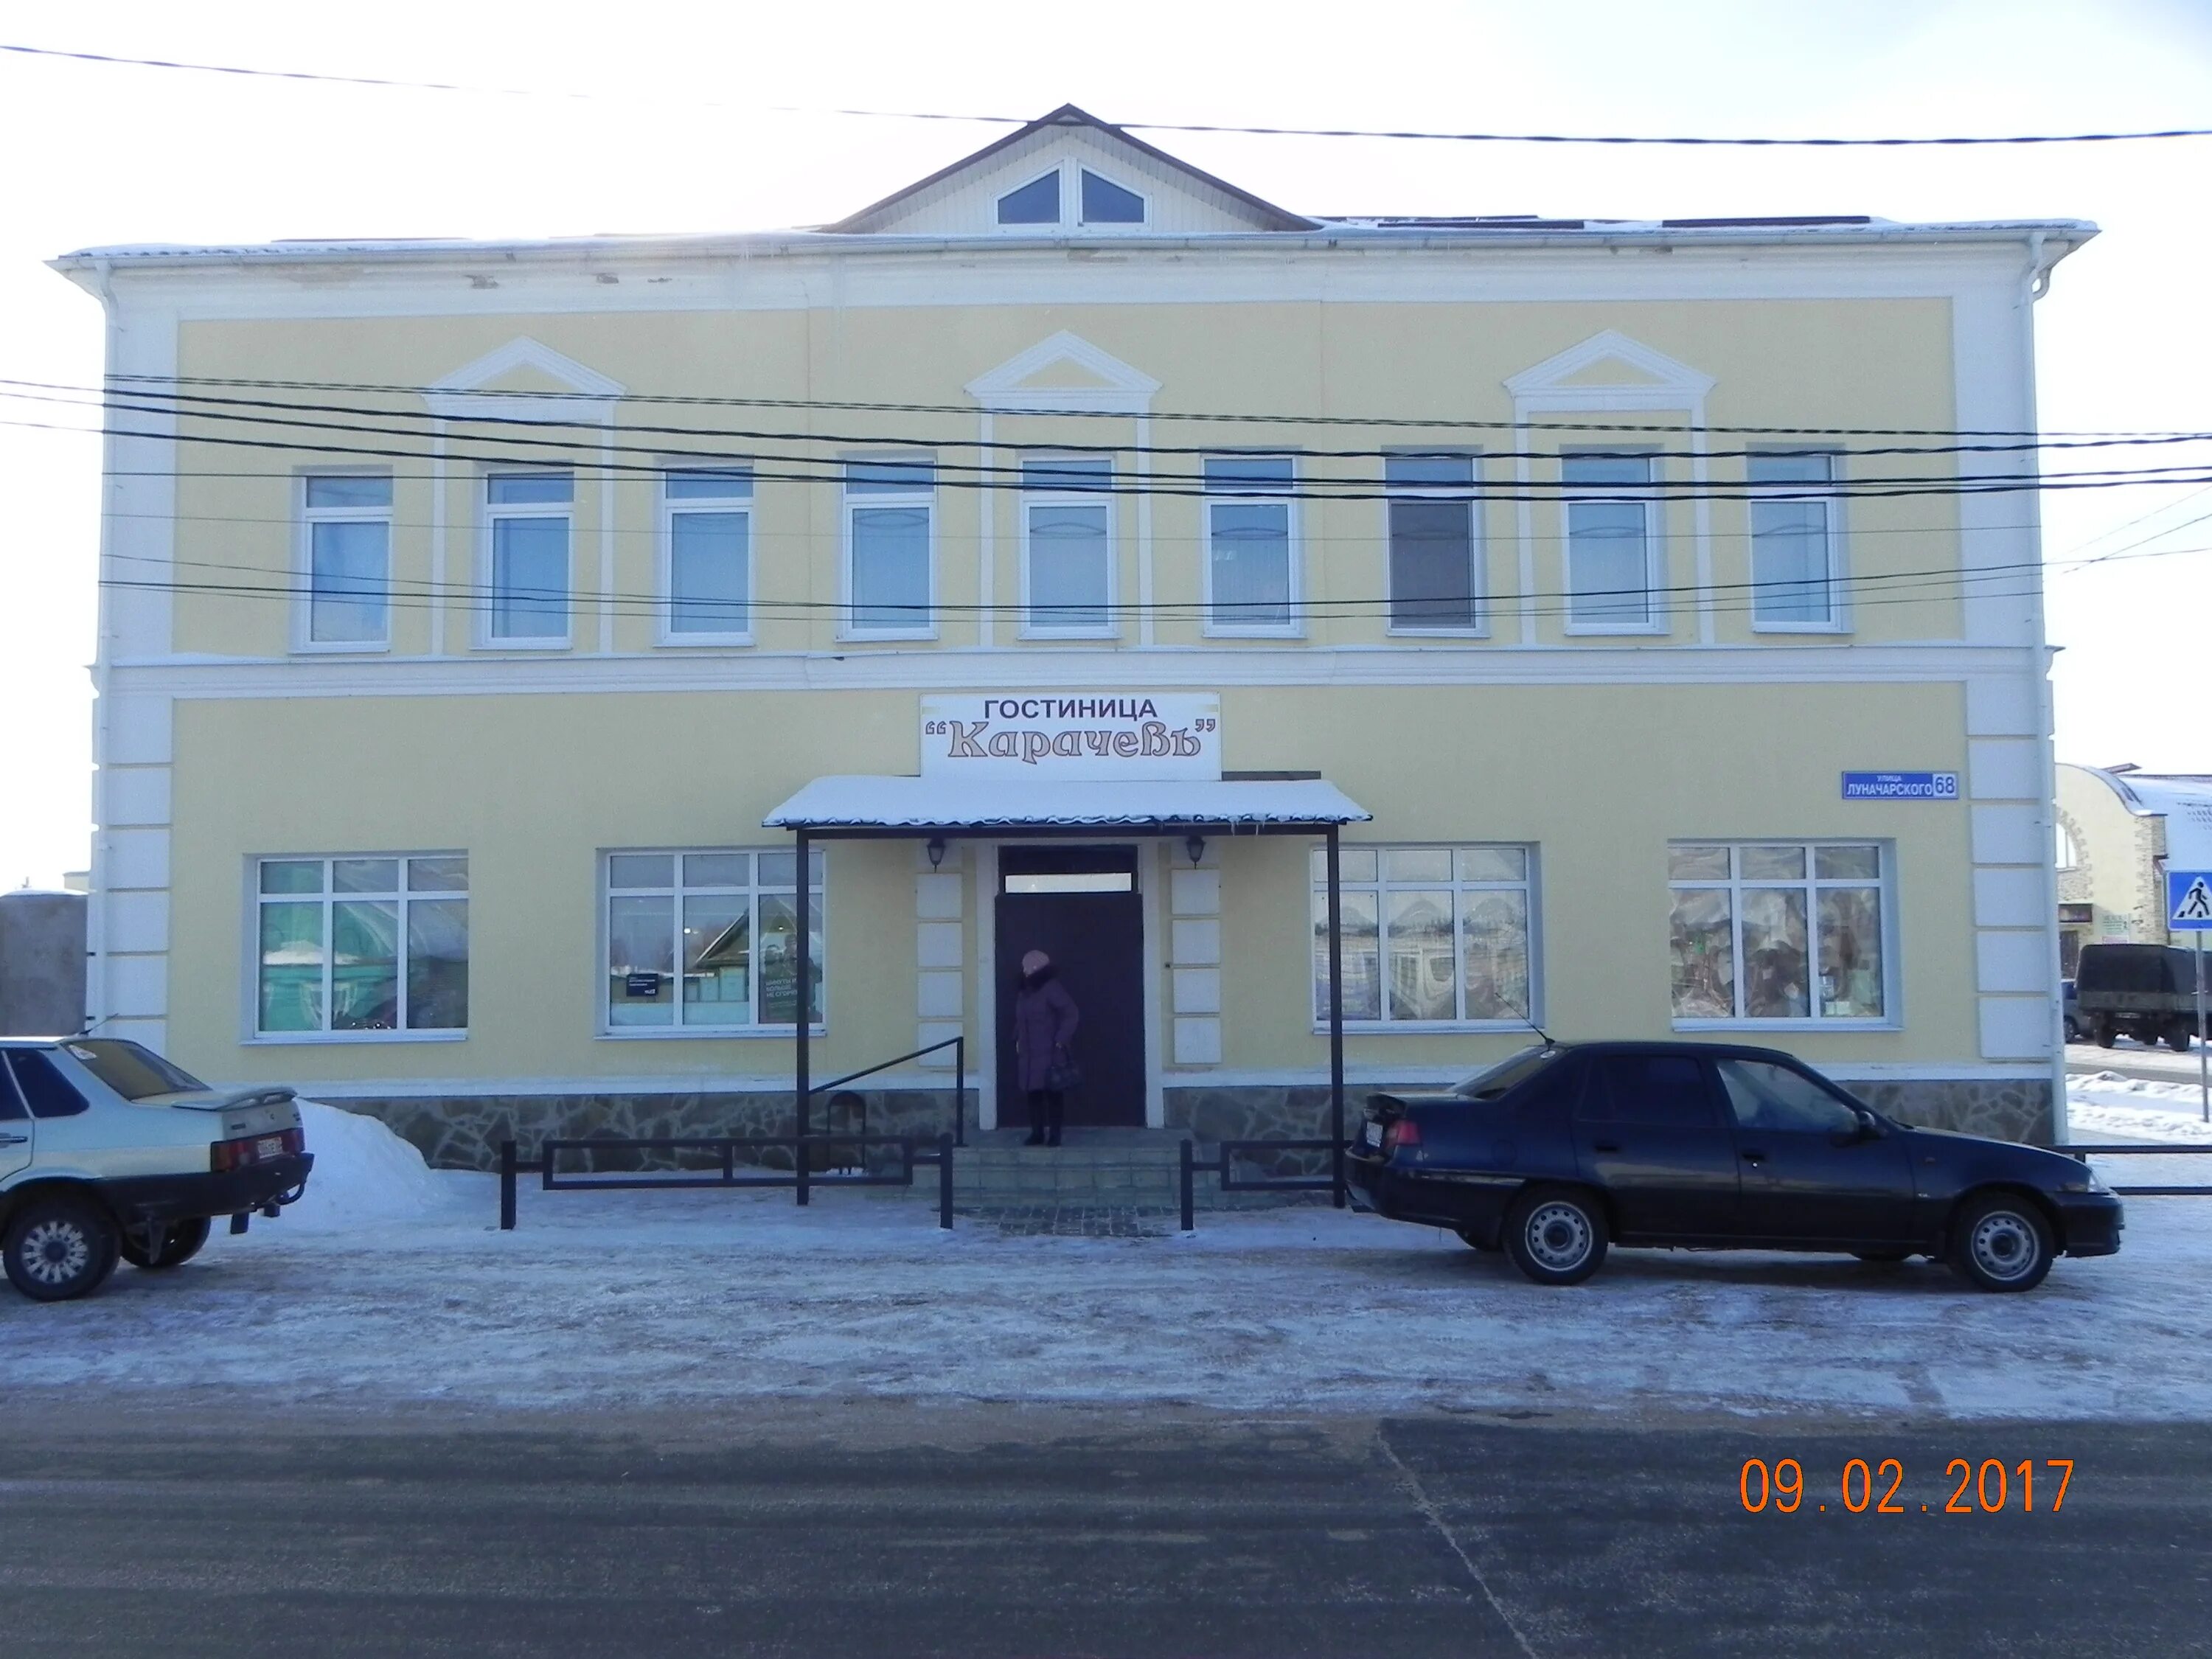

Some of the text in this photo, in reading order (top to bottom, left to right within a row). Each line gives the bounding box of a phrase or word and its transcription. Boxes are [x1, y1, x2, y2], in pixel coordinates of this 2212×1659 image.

[984, 698, 1158, 722] ГОСТИНИЦА
[1846, 783, 1933, 796] ЛУНАЧАРСКОГО
[1935, 776, 1955, 794] 68
